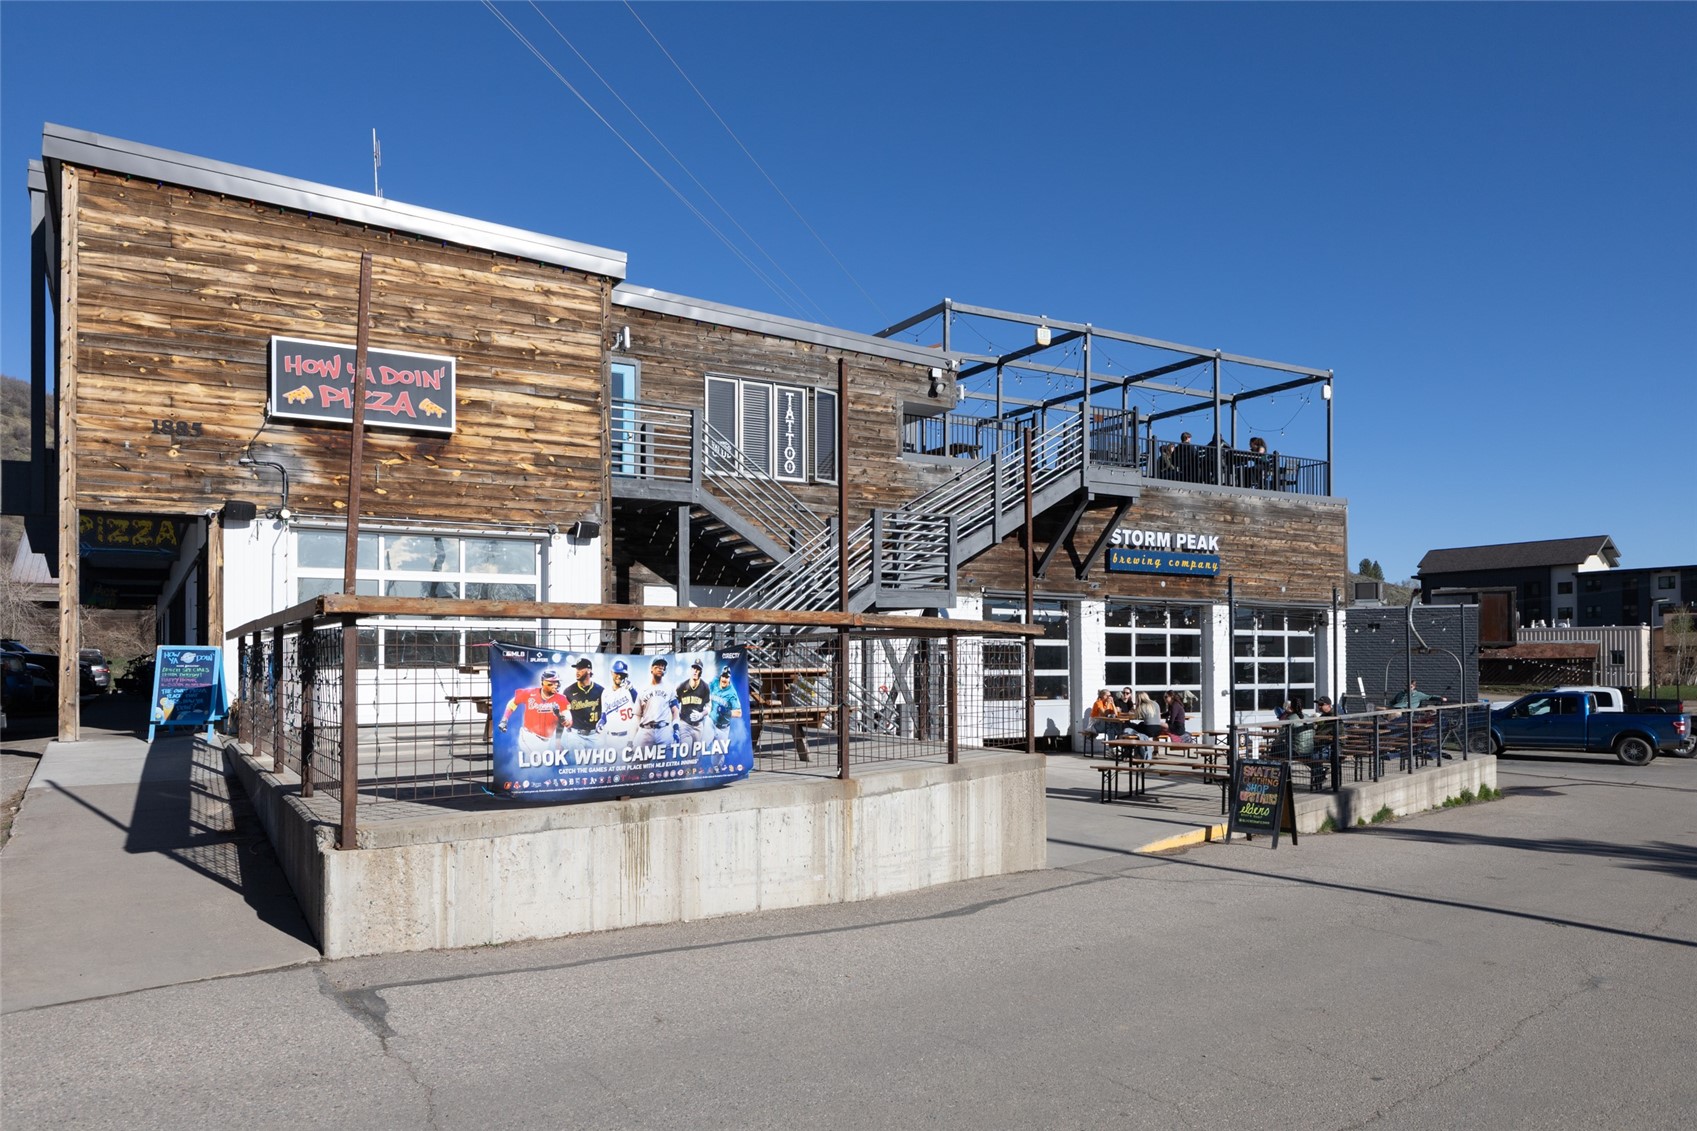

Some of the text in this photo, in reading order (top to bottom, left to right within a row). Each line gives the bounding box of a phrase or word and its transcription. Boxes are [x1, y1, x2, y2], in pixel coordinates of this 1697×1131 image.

[284, 354, 342, 380] HOW
[379, 365, 446, 391] DOIN'
[318, 384, 417, 418] PIZZA
[151, 418, 203, 437] 1885
[784, 392, 796, 474] TATTOO
[1110, 528, 1219, 551] STORM PEAK
[1112, 552, 1219, 572] brewing company
[163, 651, 181, 659] HOW
[619, 707, 633, 722] 50
[518, 739, 731, 768] LOOK WHO CAME TO PLAY
[1245, 783, 1270, 794] SHOP
